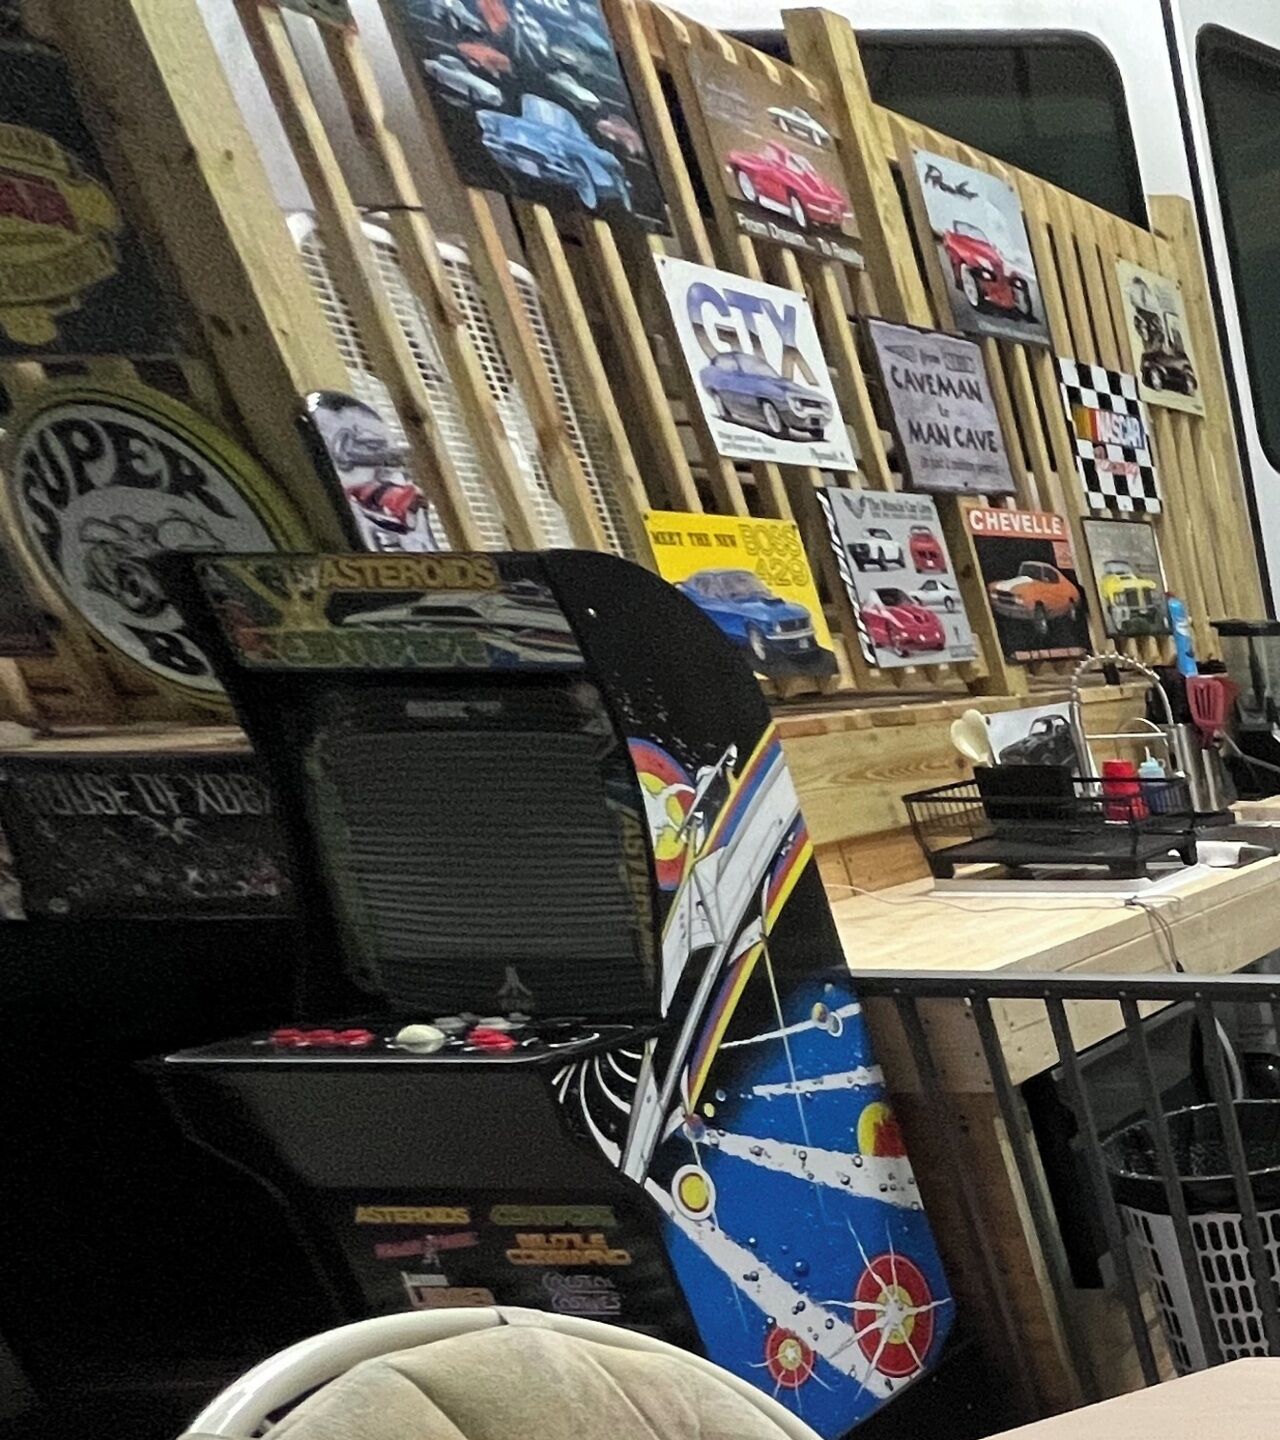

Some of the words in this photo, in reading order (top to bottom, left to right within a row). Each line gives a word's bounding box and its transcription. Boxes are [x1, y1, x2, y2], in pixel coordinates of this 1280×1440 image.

[686, 282, 820, 387] GTX
[890, 365, 983, 403] CAVEMAN
[907, 419, 951, 448] MAN
[954, 425, 998, 453] CAVE
[1096, 409, 1145, 450] NASCAR
[22, 418, 237, 586] SUPER
[650, 531, 683, 547] MEET
[688, 532, 712, 548] THE
[713, 533, 739, 549] NEW
[739, 523, 801, 558] BOSS
[968, 509, 1064, 536] CHEVELLE
[319, 554, 501, 592] ASTEROIDS
[755, 557, 811, 587] 429
[31, 773, 139, 815] OUSE
